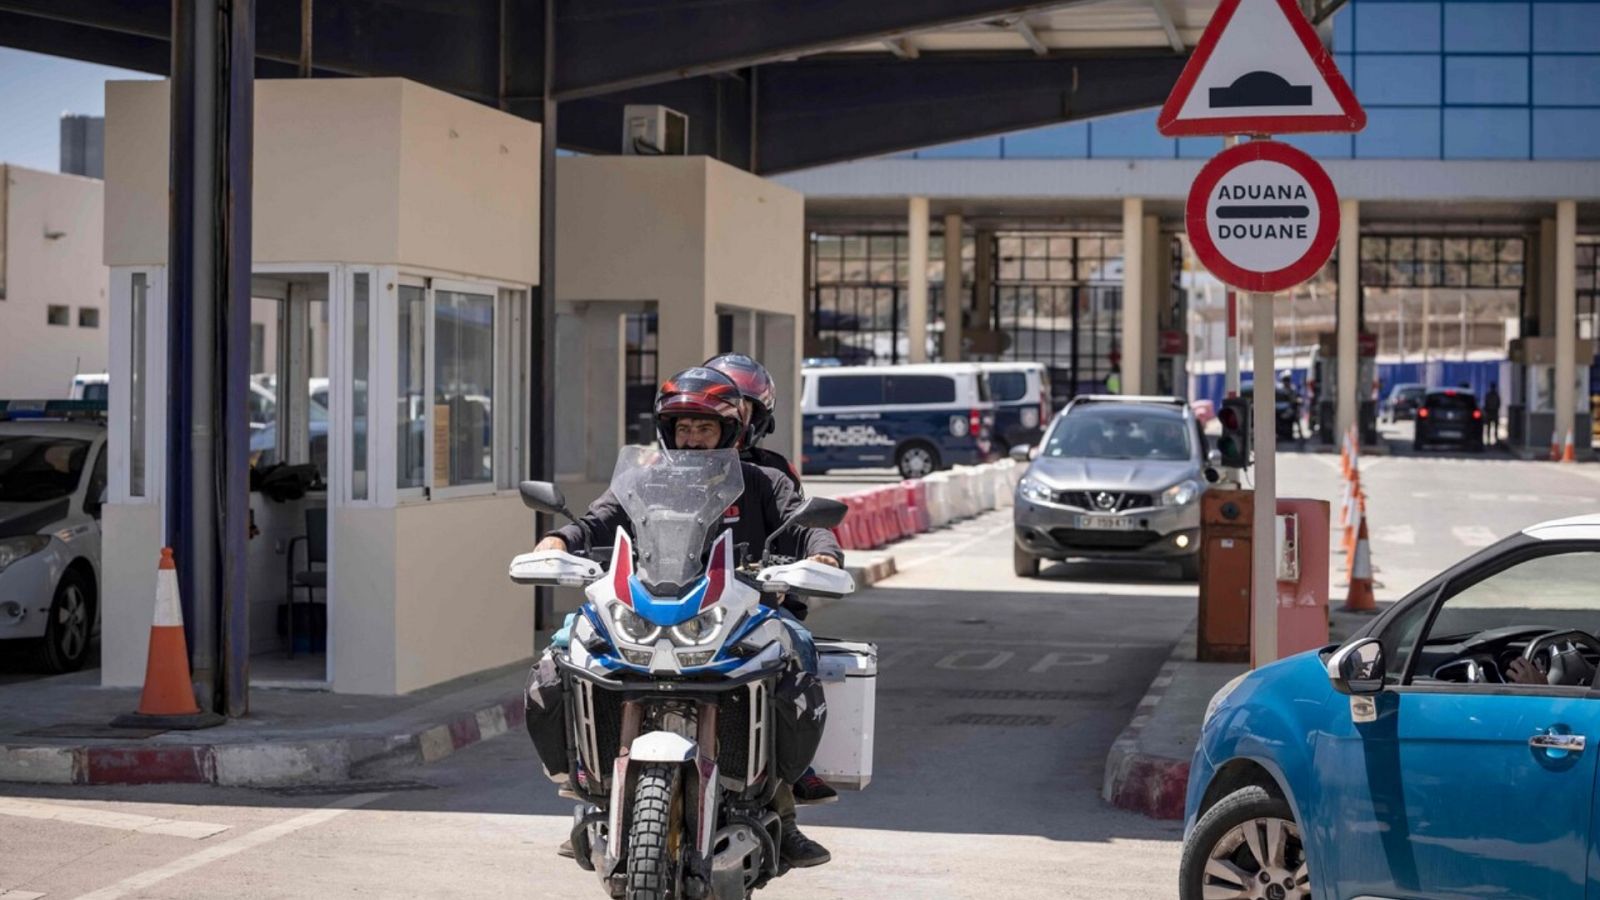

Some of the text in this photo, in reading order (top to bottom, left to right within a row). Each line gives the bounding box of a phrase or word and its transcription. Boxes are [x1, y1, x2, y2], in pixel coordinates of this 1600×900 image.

[1218, 185, 1307, 200] ADUANA
[1218, 224, 1308, 239] DOUANE
[812, 434, 896, 447] NACIONAL
